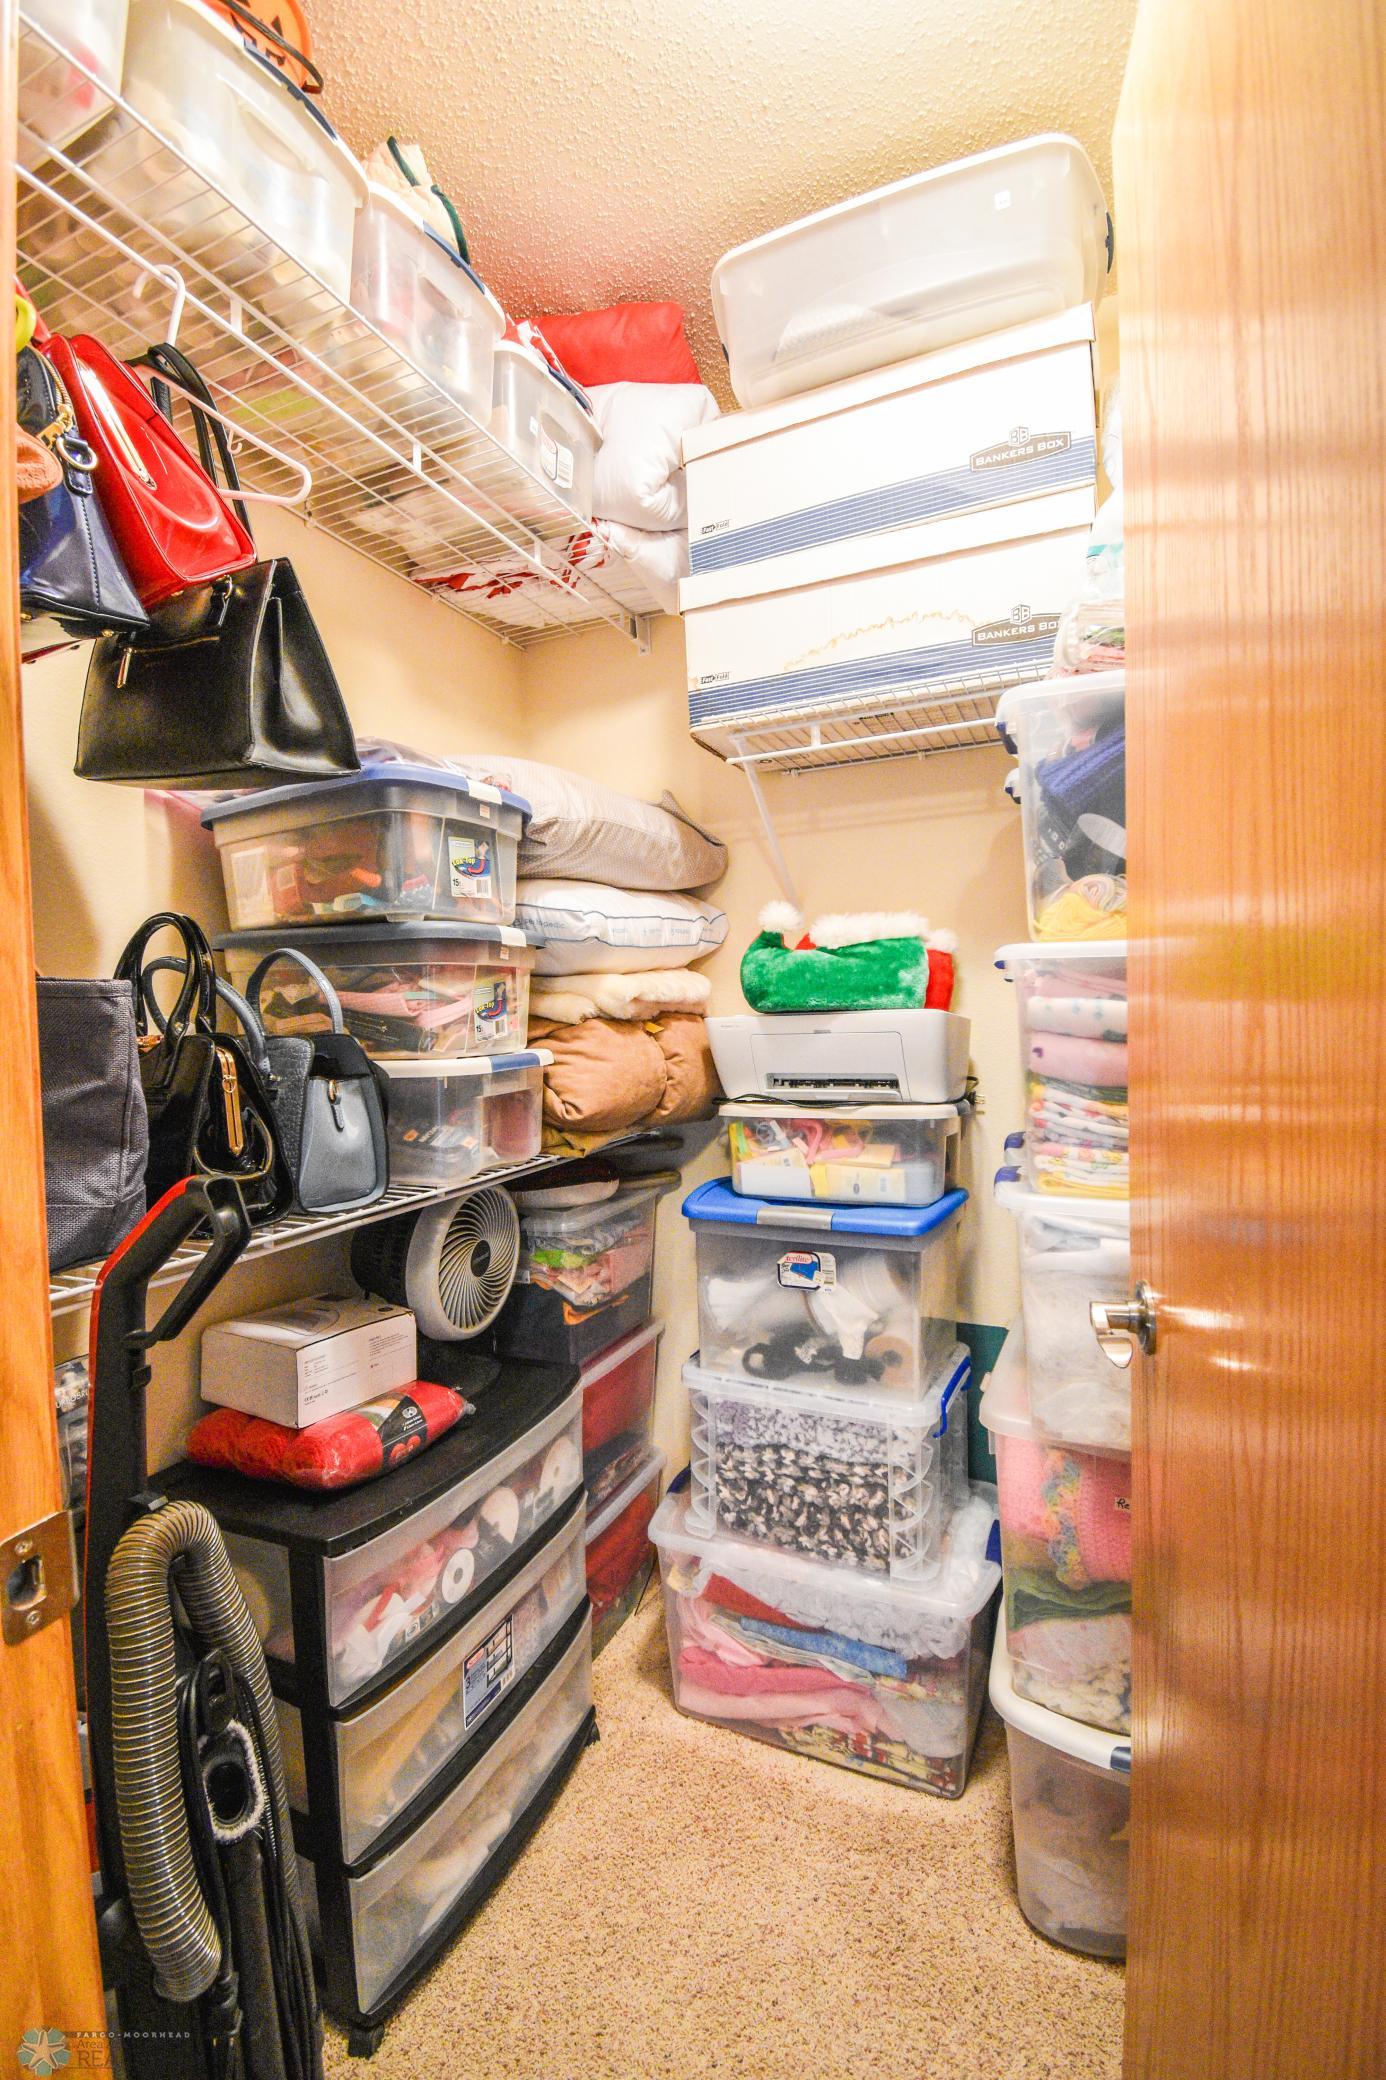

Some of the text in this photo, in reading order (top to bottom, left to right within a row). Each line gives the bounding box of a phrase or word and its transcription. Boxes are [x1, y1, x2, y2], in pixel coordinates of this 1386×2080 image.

[975, 438, 1065, 466] BANKERS BOX
[977, 621, 1060, 641] BANKERS BO
[452, 879, 460, 887] 15
